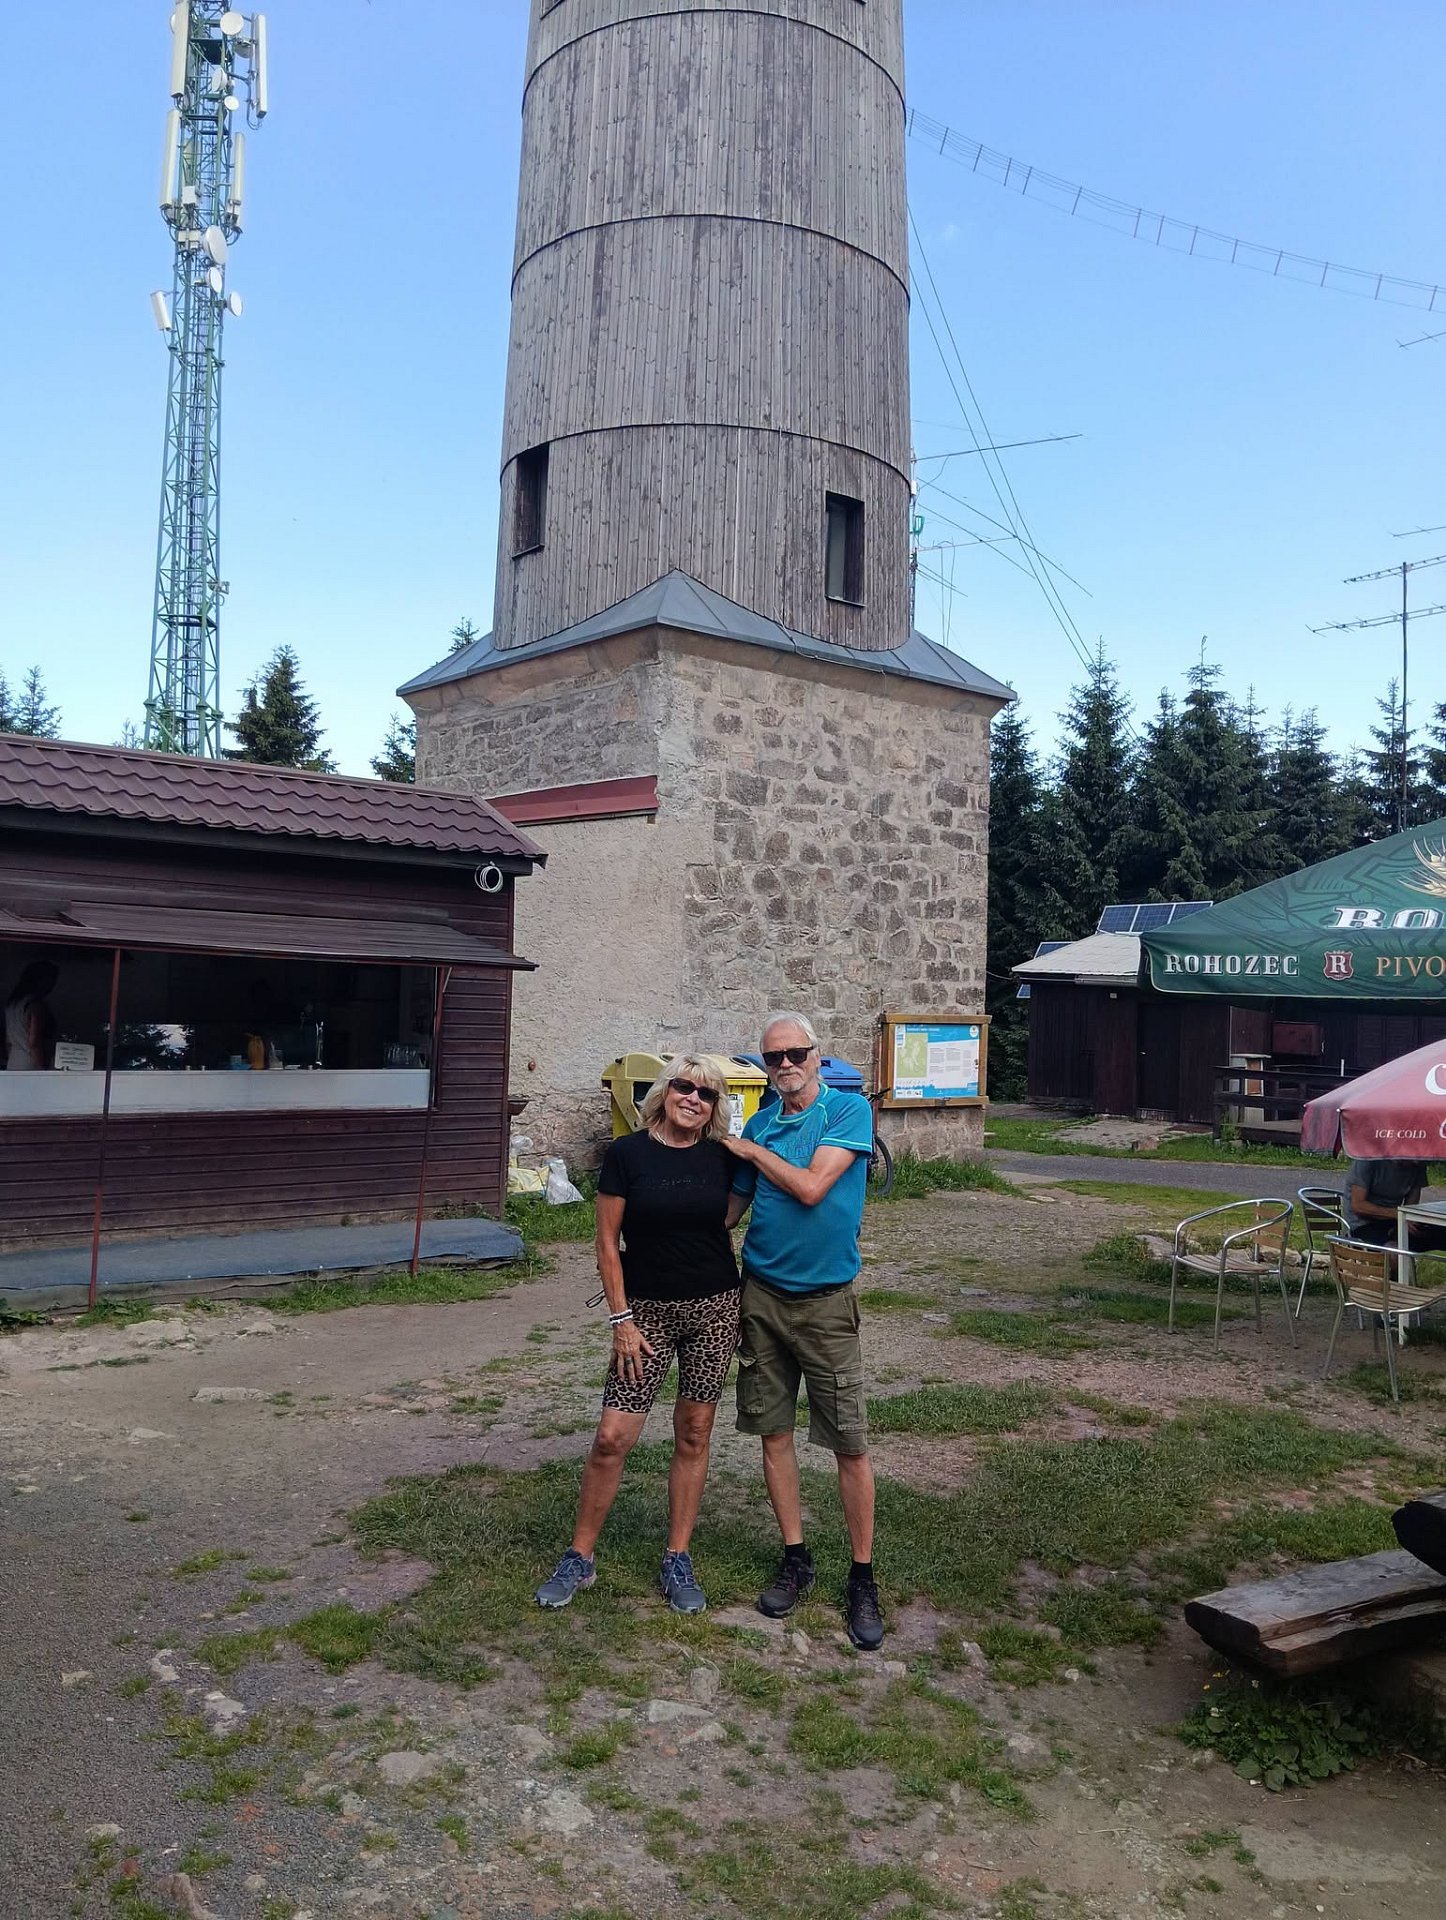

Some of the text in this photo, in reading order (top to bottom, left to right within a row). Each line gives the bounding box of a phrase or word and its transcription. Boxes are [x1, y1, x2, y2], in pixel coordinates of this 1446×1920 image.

[1164, 954, 1299, 976] ROHOZEC
[1329, 954, 1348, 974] R
[1376, 955, 1446, 978] PIVO
[1375, 1129, 1427, 1139] ICE COLD
